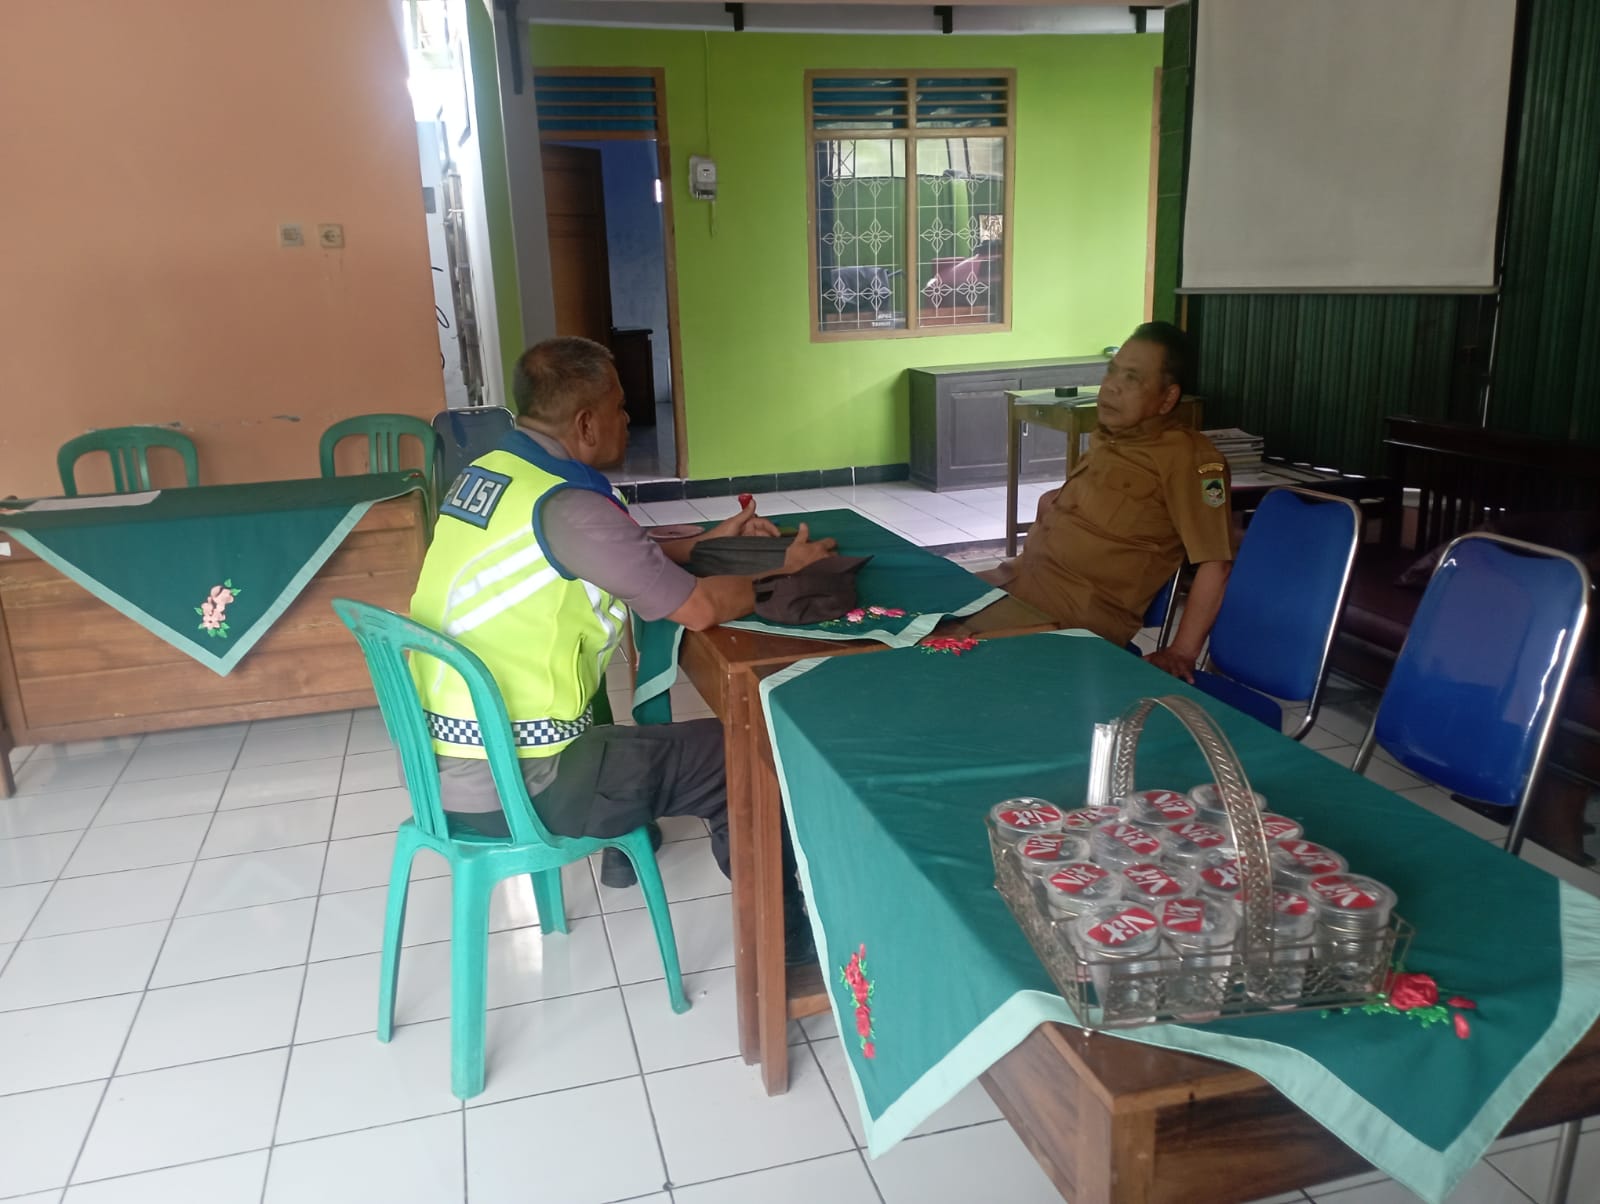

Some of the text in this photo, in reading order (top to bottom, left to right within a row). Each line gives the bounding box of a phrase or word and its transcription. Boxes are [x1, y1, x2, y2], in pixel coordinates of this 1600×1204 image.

[1154, 793, 1190, 815] Vit
[1012, 807, 1058, 829] Vit
[1028, 834, 1062, 856] Vit
[1114, 825, 1157, 848] Vit
[1179, 823, 1221, 844] Vit
[1293, 844, 1336, 868] Vit
[1051, 865, 1100, 887] Vit
[1127, 868, 1169, 894] Vit
[1316, 883, 1360, 907] Vit
[1166, 901, 1202, 926] Vit
[1101, 914, 1155, 944] Vit
